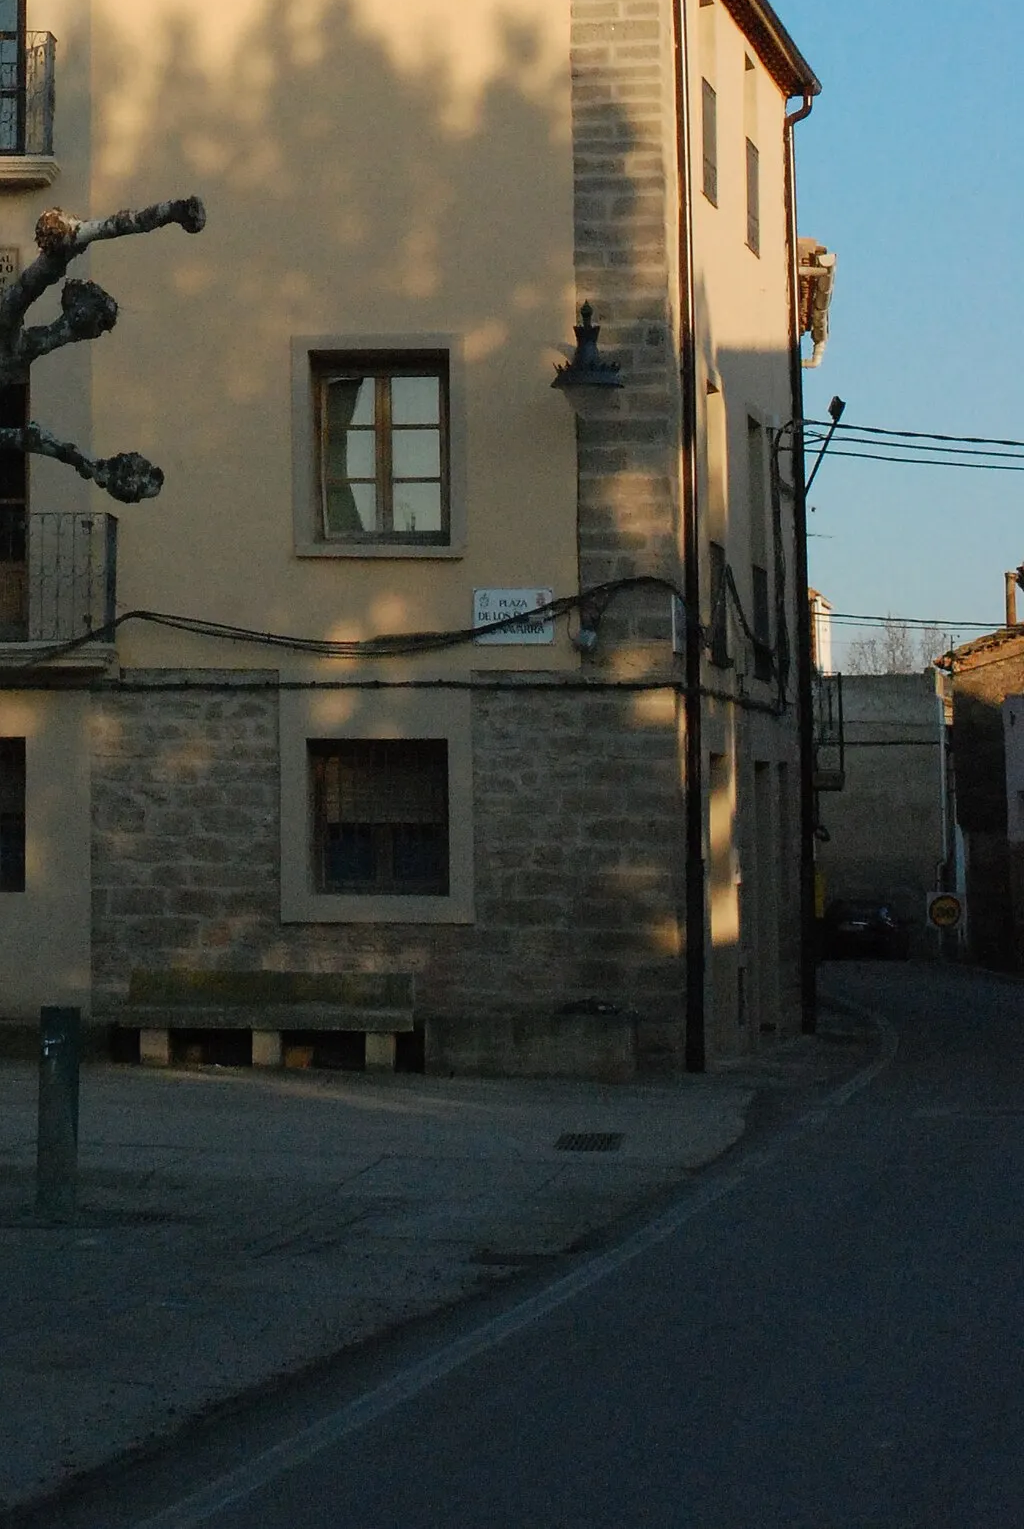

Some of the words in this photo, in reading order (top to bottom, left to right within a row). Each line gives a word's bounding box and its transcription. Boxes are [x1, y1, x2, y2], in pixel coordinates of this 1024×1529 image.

[499, 599, 528, 608] PLAZA
[478, 611, 491, 621] DE
[493, 611, 511, 621] LOS
